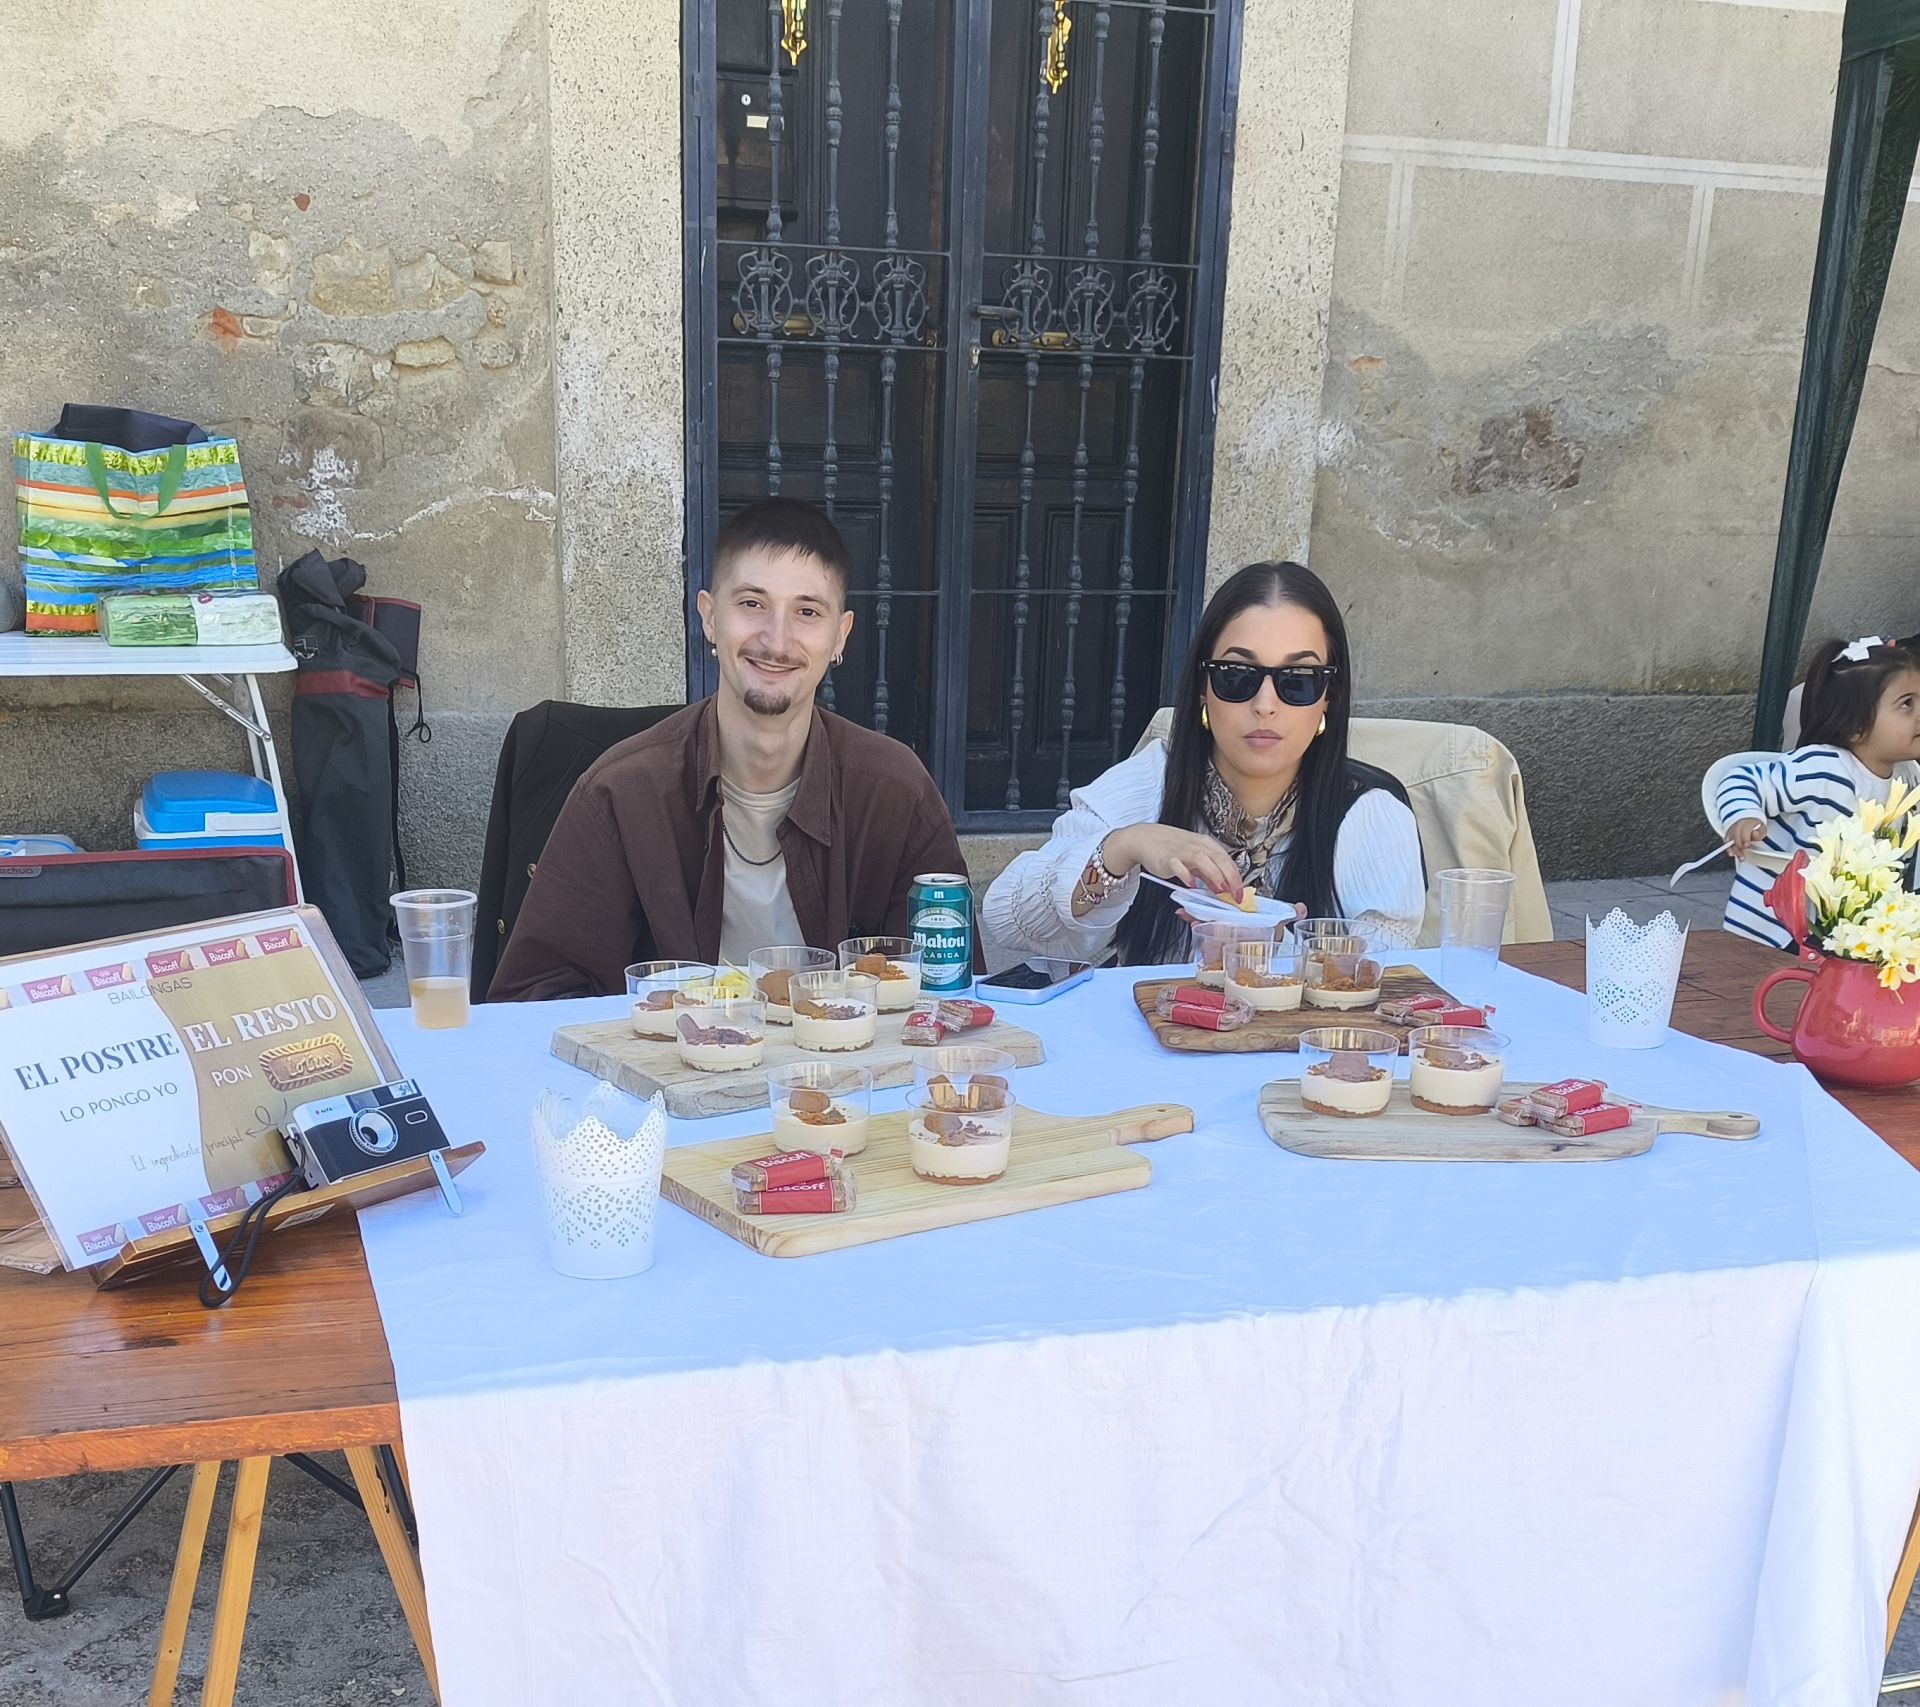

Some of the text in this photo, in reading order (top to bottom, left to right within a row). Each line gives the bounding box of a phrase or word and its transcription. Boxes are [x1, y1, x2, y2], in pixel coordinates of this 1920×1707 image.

[263, 937, 290, 951] Biscoff
[913, 932, 965, 949] Mahou
[208, 948, 236, 963] Biscoff
[922, 951, 960, 959] LÁSICA
[151, 961, 180, 974] Biscoff
[92, 971, 123, 987] Biscoff
[29, 984, 61, 1000] Biscoff
[107, 976, 193, 1005] BAILONGAS
[182, 994, 337, 1052] EL RESTO
[14, 1032, 180, 1090] EL POSTRE
[211, 1065, 253, 1087] PON
[60, 1082, 178, 1122] LO PONGO YO
[130, 1154, 146, 1172] El
[204, 1128, 244, 1158] principal
[756, 1152, 812, 1169] Biscoff
[146, 1216, 177, 1233] Biscoff
[84, 1235, 114, 1252] Biscoff
